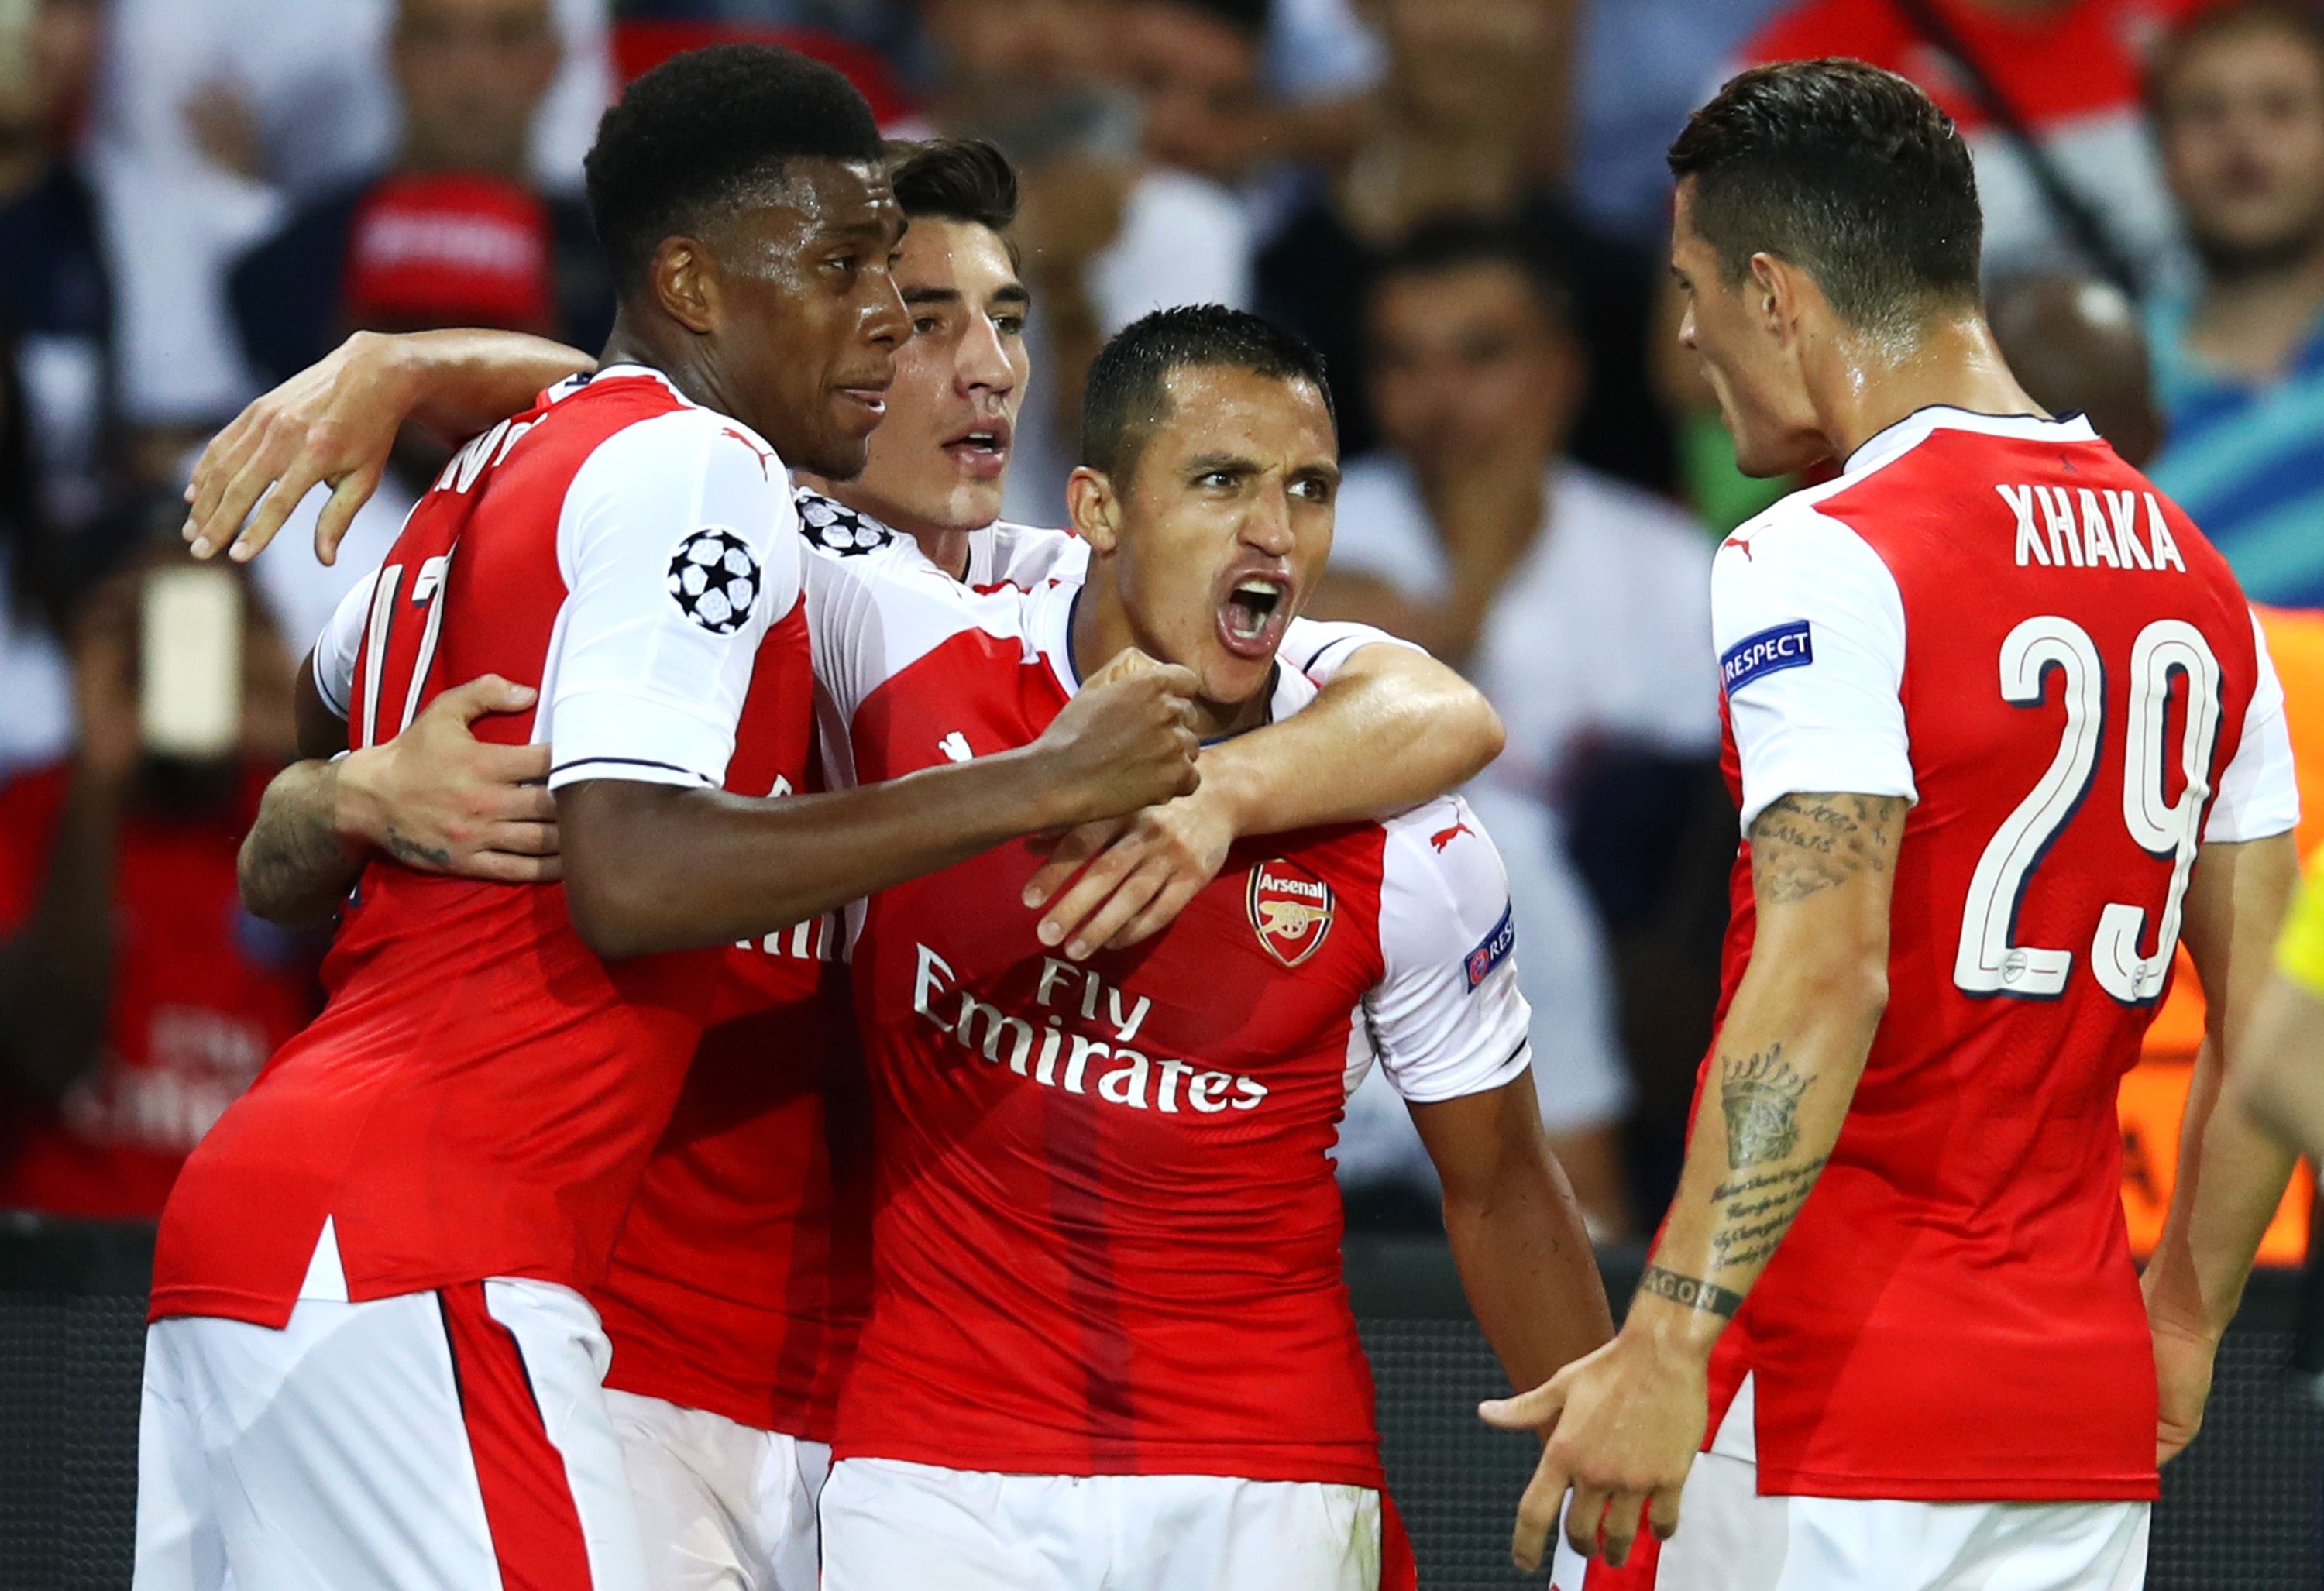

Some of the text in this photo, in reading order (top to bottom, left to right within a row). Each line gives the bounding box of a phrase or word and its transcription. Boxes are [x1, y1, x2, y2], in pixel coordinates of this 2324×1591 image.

[1996, 483, 2186, 572] XHAKA
[1725, 632, 1808, 682] RESPECT
[1954, 616, 2221, 1005] 29
[1260, 873, 1323, 899] Arsenal
[913, 942, 1268, 1113] Emirates
[1038, 956, 1152, 1041] Fly
